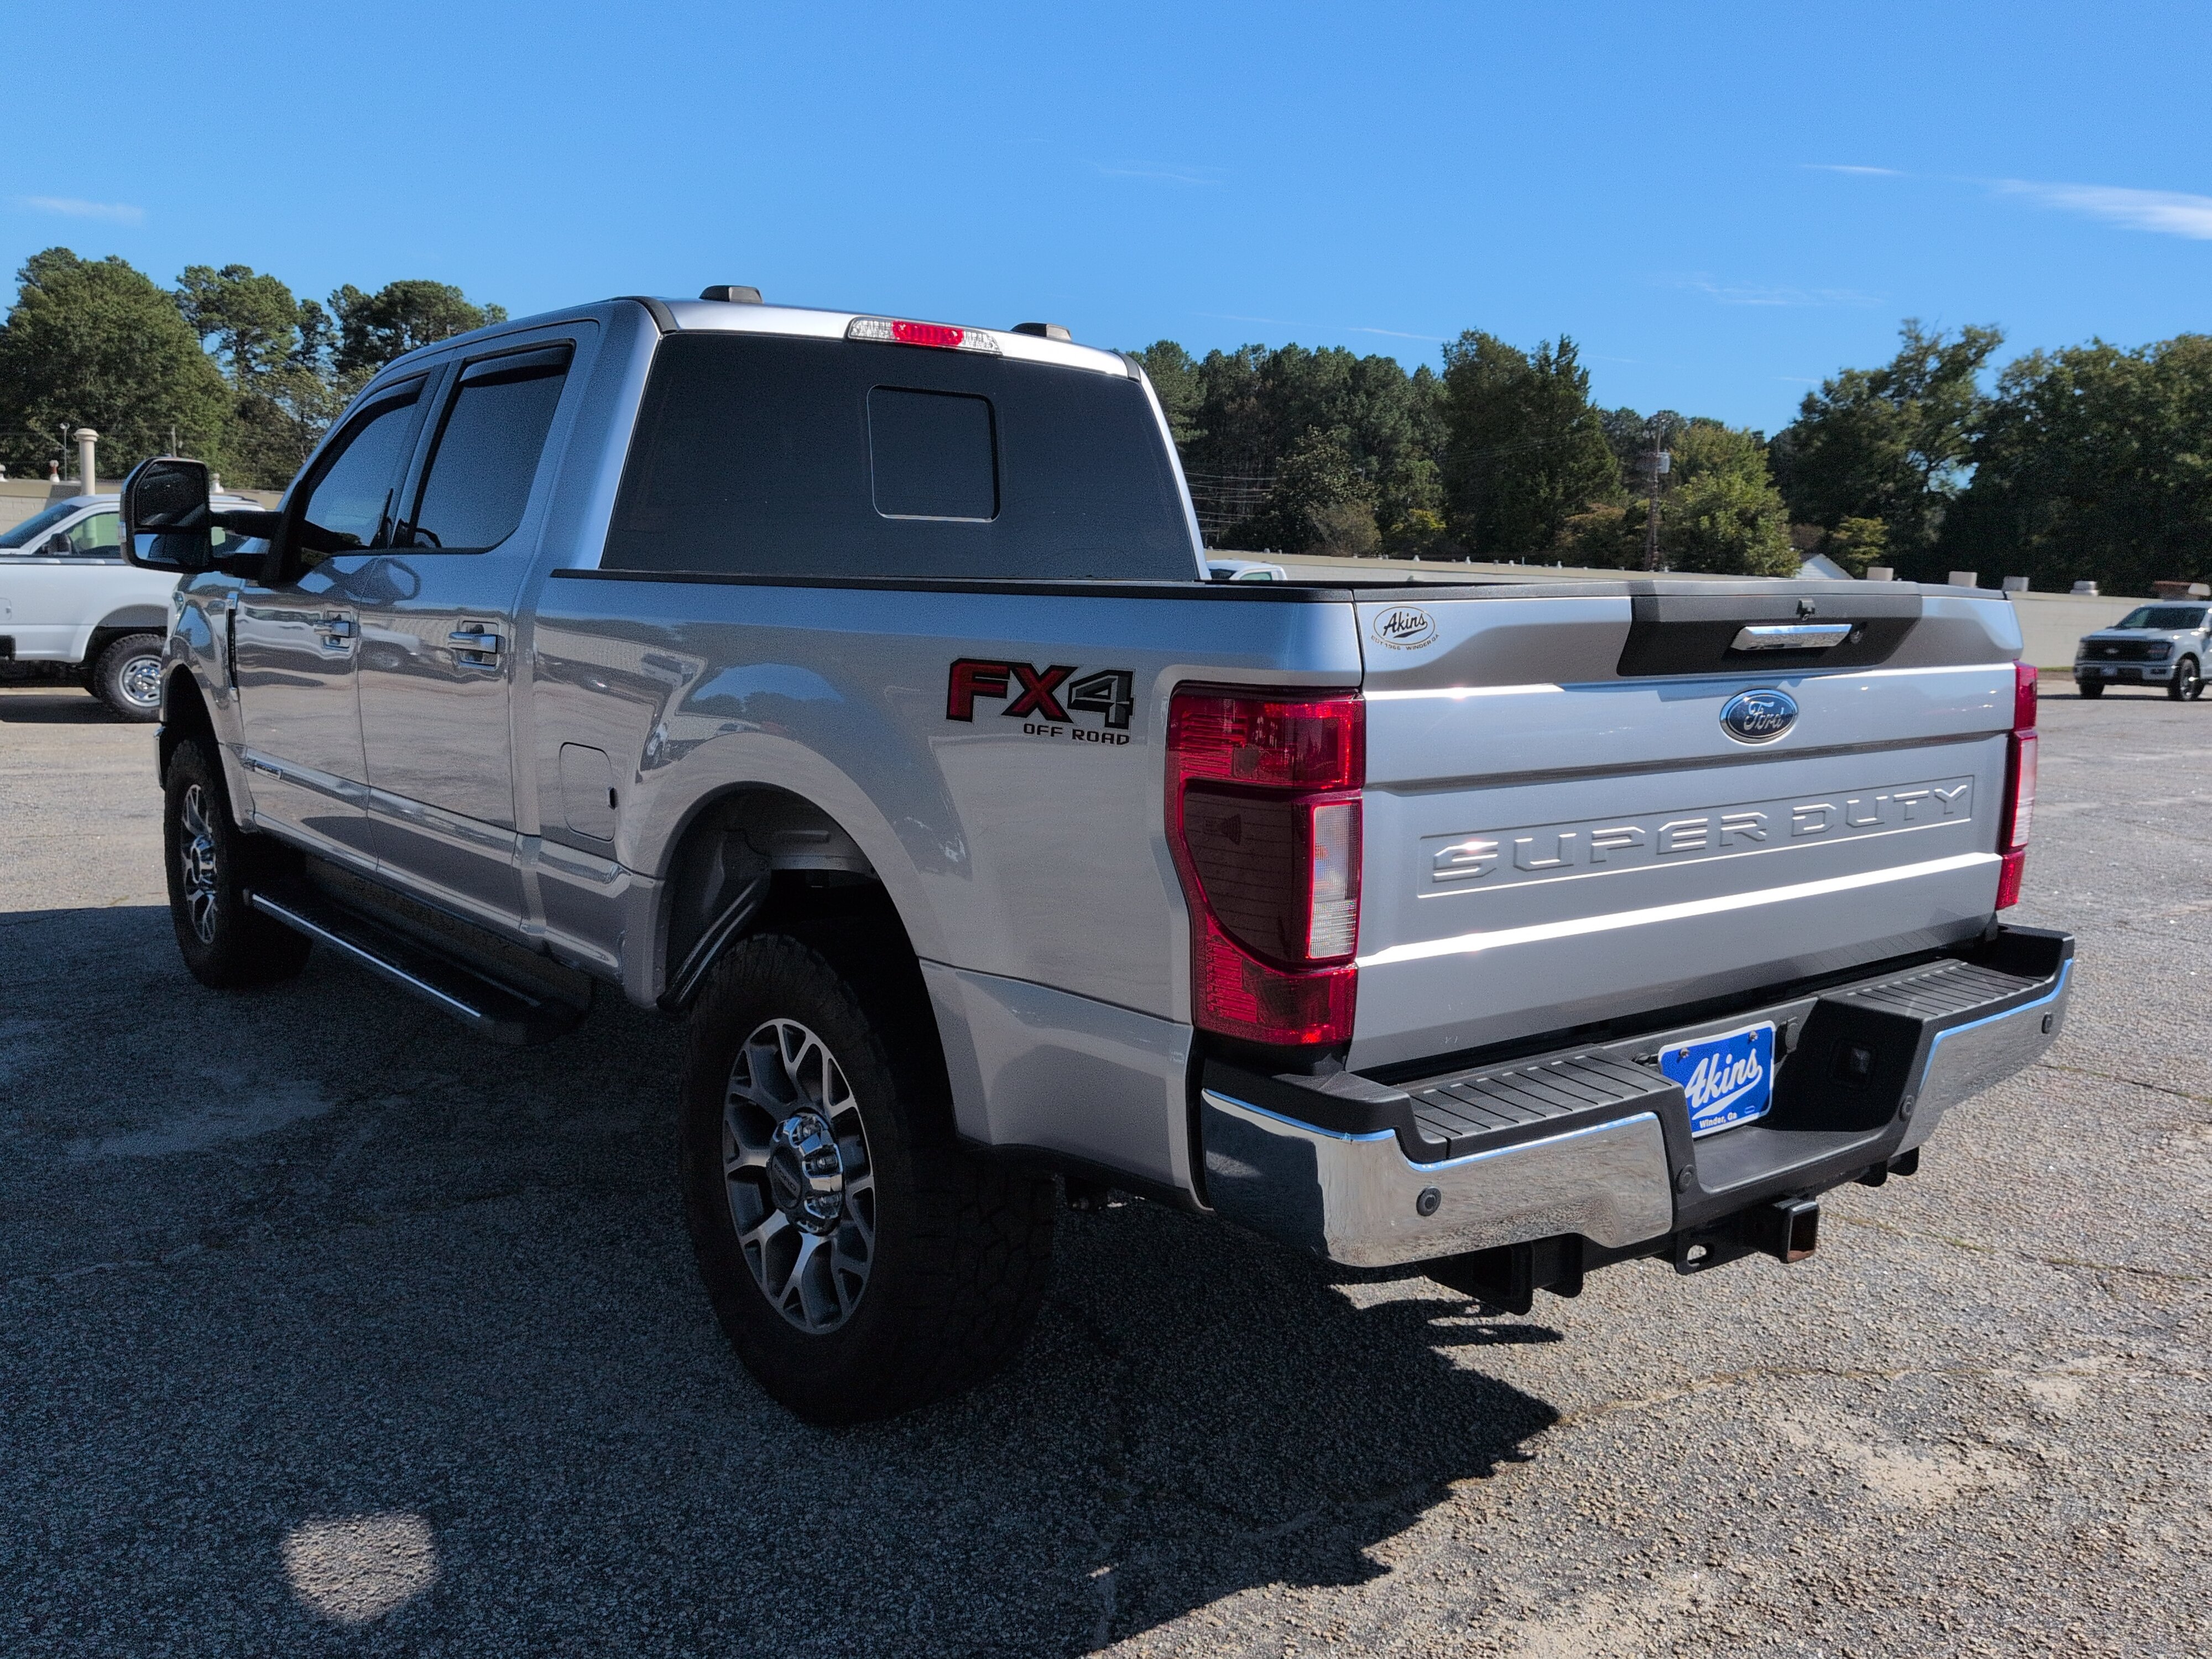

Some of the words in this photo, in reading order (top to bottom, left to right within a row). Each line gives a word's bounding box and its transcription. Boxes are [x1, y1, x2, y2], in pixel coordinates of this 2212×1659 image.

[1383, 611, 1428, 638] Akins
[1405, 640, 1432, 651] WINDER
[946, 658, 1135, 730] FX4
[1744, 701, 1785, 731] Ford
[1023, 723, 1063, 737] OFF
[1071, 728, 1130, 745] ROAD
[1432, 812, 1768, 884] SUPER
[1791, 784, 1969, 837] DUTY
[1684, 1048, 1763, 1120] Akins
[1699, 1116, 1726, 1129] Winder,
